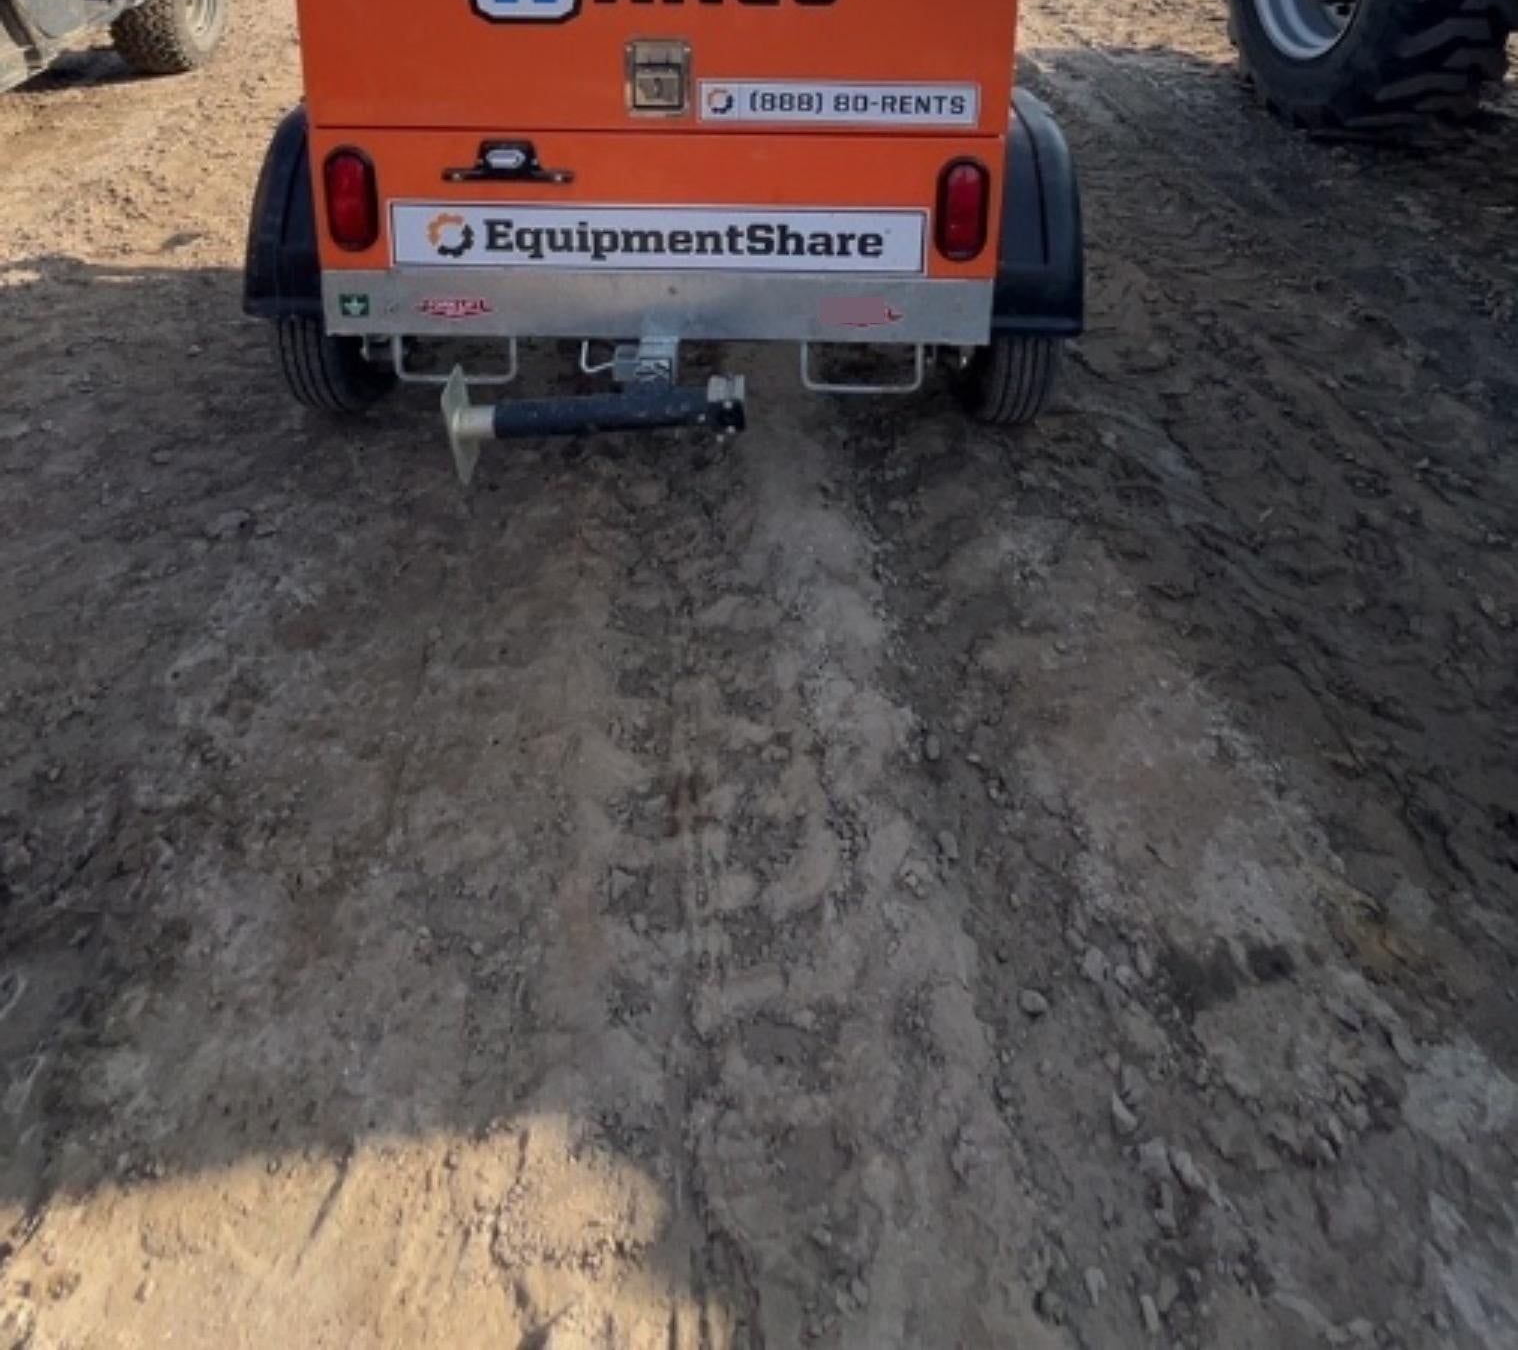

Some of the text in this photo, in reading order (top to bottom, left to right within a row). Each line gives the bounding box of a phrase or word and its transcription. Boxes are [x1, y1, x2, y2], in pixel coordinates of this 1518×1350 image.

[749, 90, 967, 116] (888) 80-RENTS
[484, 219, 884, 261] EquipmentShare
